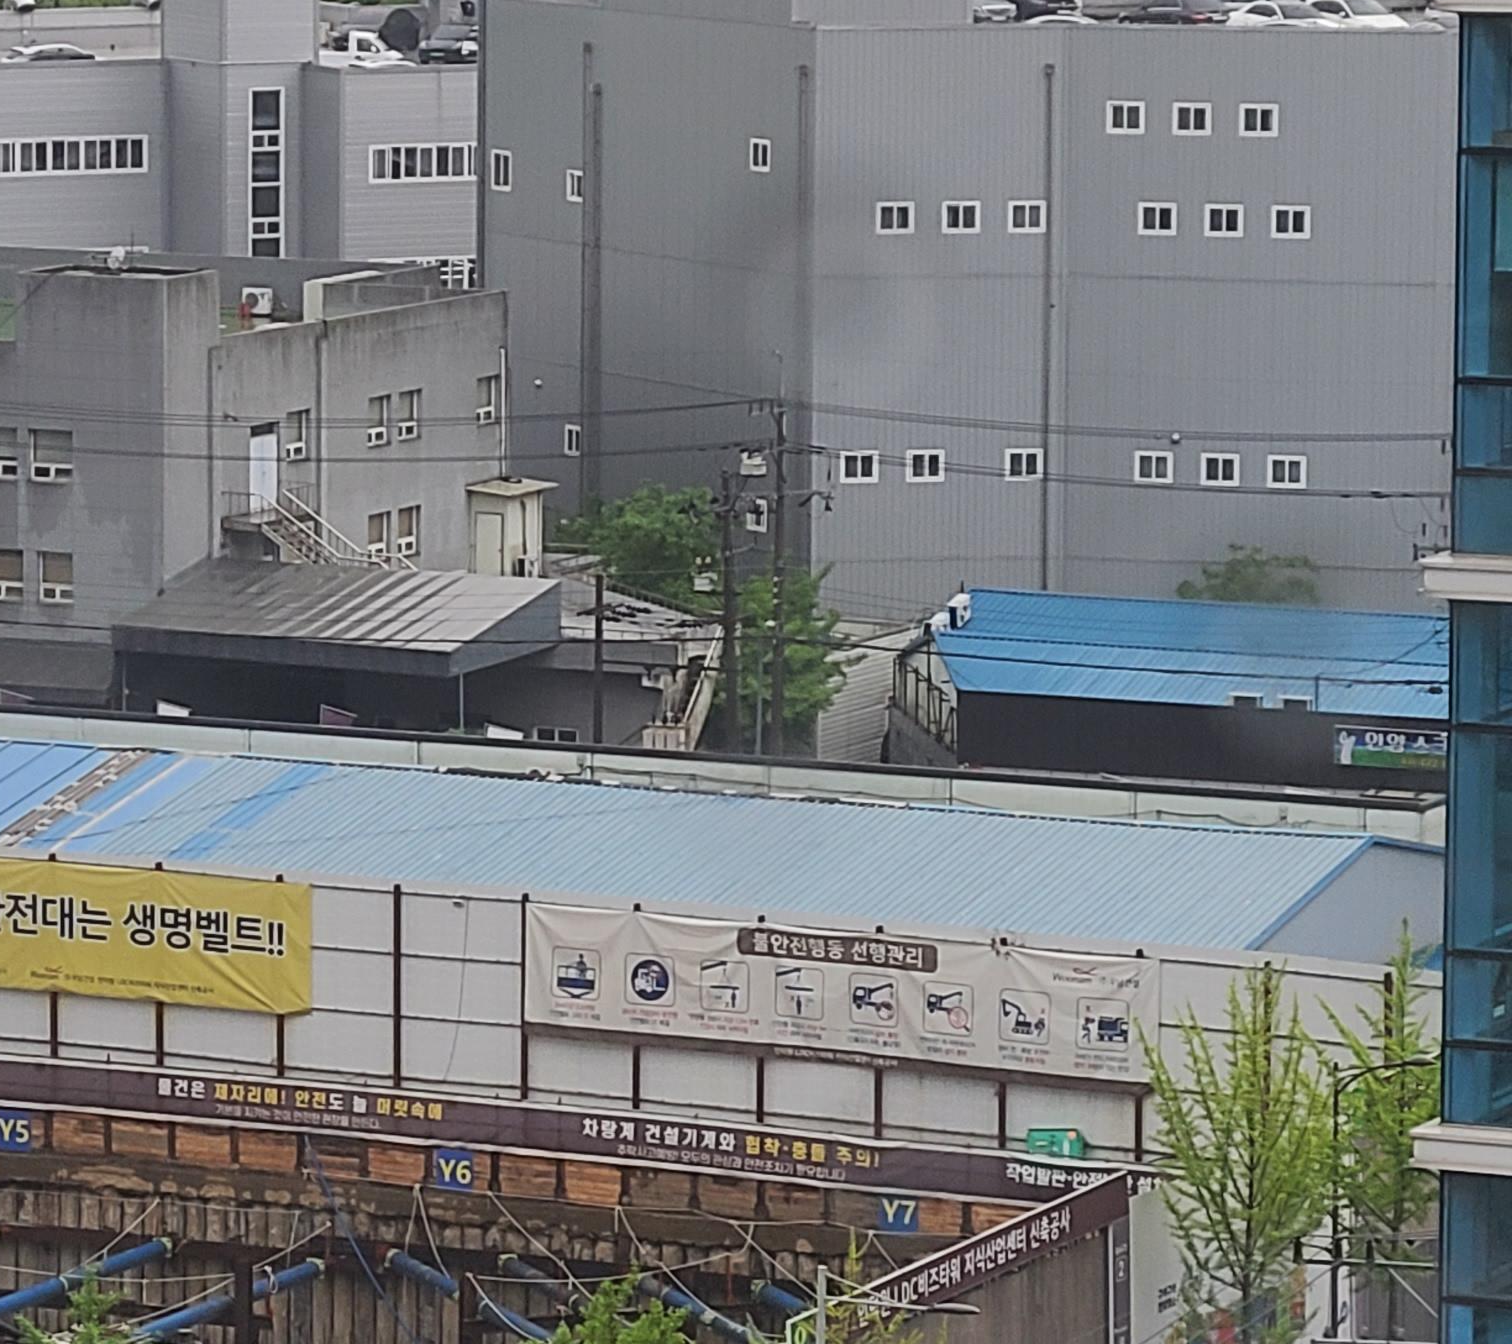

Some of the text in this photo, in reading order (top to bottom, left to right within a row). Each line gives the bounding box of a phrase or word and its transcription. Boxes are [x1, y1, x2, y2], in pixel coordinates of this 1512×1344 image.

[122, 903, 285, 956] 생명벨트!!
[752, 932, 923, 968] 불안전행동 선행관리
[295, 1089, 344, 1111] 안전도
[645, 1124, 736, 1152] 건설기계와
[835, 1147, 880, 1168] 주의!
[438, 1158, 472, 1184] Y6
[882, 1198, 917, 1224] Y7
[964, 1224, 1027, 1277] 지식산업센터
[1029, 1206, 1072, 1248] 신축공사
